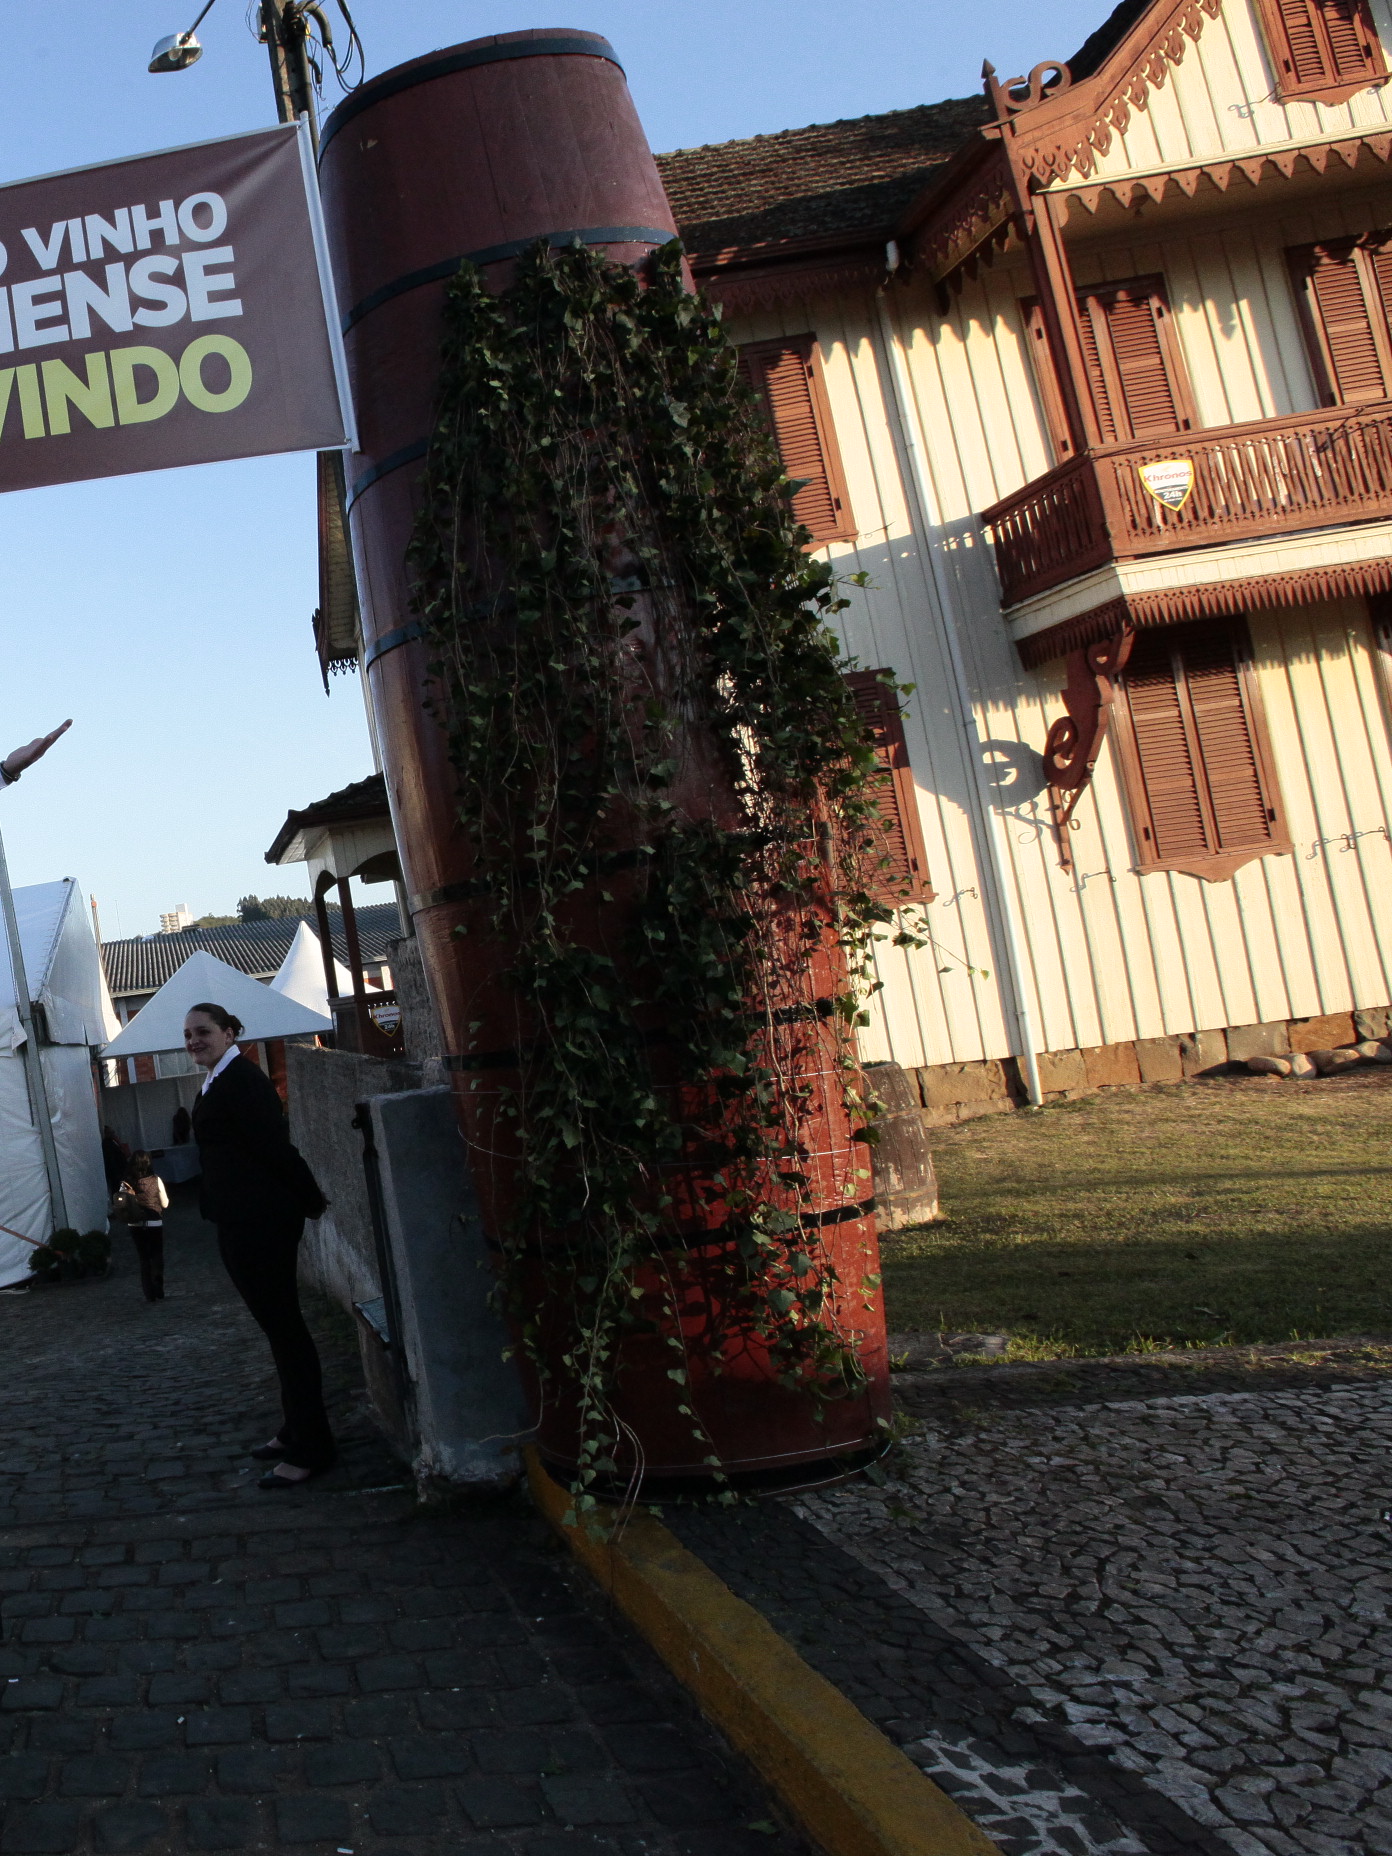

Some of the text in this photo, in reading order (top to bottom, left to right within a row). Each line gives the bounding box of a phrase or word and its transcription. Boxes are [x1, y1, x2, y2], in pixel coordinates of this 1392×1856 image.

[21, 191, 228, 271] VINHO
[1143, 470, 1193, 483] Khronos
[1163, 490, 1183, 500] 24h
